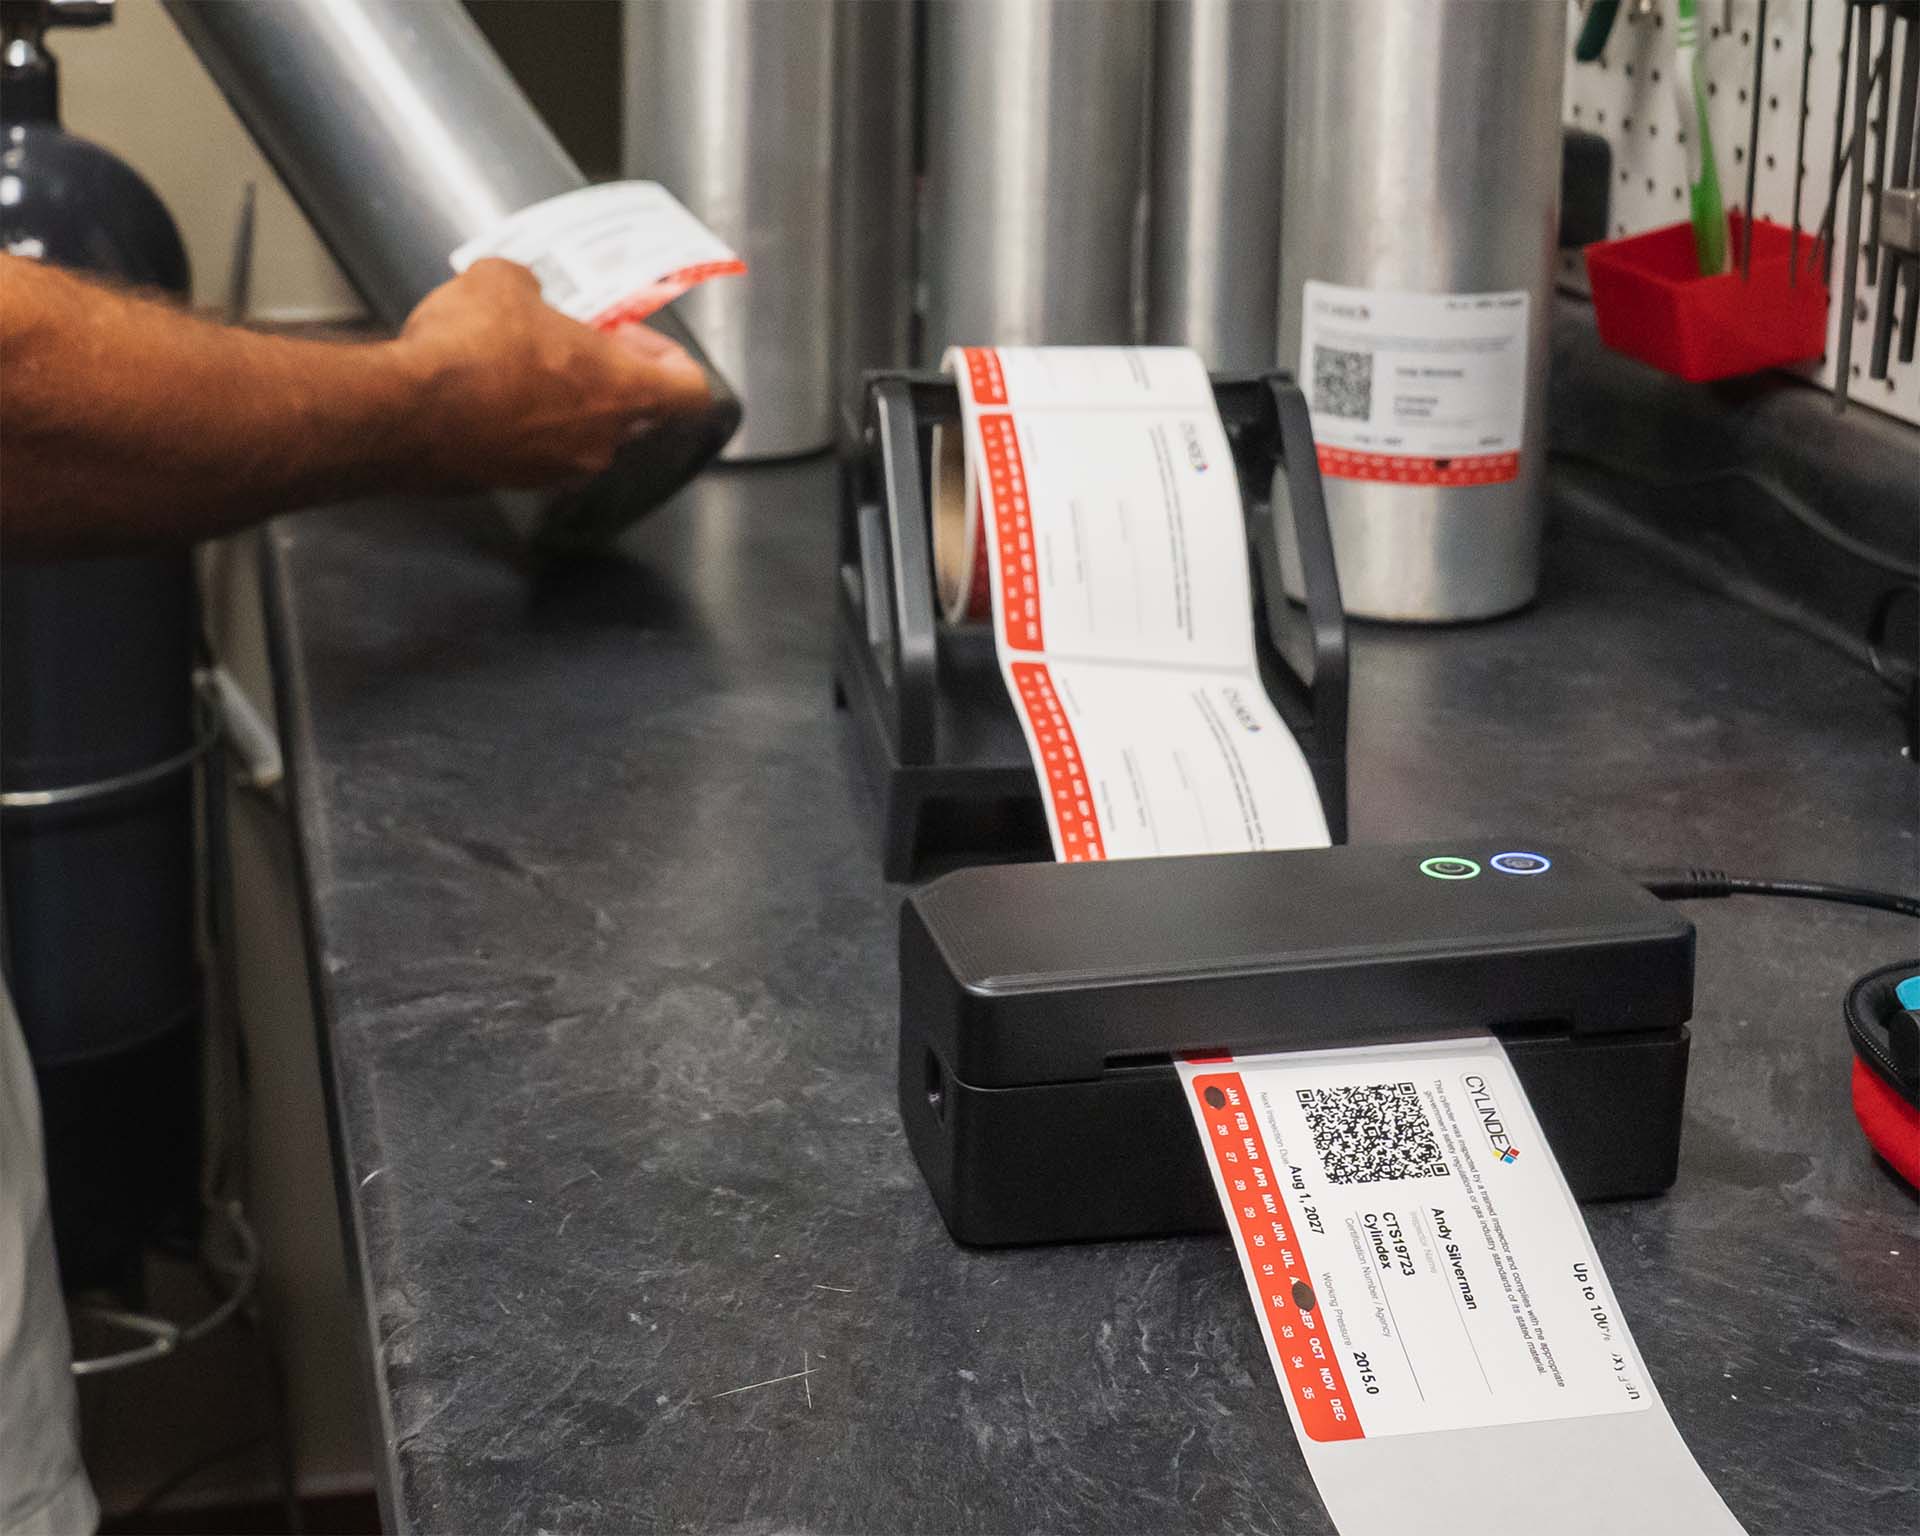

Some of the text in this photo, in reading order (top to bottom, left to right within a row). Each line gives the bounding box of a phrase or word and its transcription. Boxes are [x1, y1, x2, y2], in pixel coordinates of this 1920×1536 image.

[1261, 1091, 1271, 1108] Next
[1266, 1109, 1283, 1147] Inspection
[1465, 1075, 1517, 1161] CYLINDEX
[1288, 1165, 1305, 1189] Aug
[1299, 1193, 1311, 1203] 1,
[1303, 1206, 1324, 1234] 2027
[1363, 1213, 1391, 1269] Cylindex
[1382, 1211, 1415, 1276] CTS19723
[1409, 1211, 1437, 1273] Inspector Name
[1423, 1090, 1547, 1374] government safety regulations or gas industry standards of its stated material.
[1433, 1079, 1443, 1093] This
[1439, 1095, 1455, 1122] cylinder
[1451, 1123, 1461, 1138] was
[1458, 1139, 1478, 1172] inspected
[1472, 1173, 1480, 1182] by
[1479, 1190, 1496, 1216] trained
[1491, 1217, 1510, 1253] inspector
[1505, 1255, 1518, 1270] and
[1512, 1271, 1531, 1308] complies
[1527, 1309, 1539, 1326] with
[1534, 1327, 1544, 1340] the
[1539, 1342, 1565, 1387] appropriate
[1216, 1124, 1314, 1399] 26 27 28 29 30 31 32 33 34 35
[1225, 1087, 1346, 1421] JAN FEB MAR APR MAY JUN JUL SEP OCT NOV DEC
[1344, 1217, 1366, 1264] Certification
[1361, 1266, 1378, 1299] Number
[1375, 1306, 1390, 1336] Agency
[1431, 1208, 1477, 1309] Andy Silverman
[1573, 1262, 1587, 1282] Up
[1582, 1286, 1595, 1300] to
[1322, 1271, 1338, 1306] Working
[1352, 1351, 1379, 1394] 2015.0
